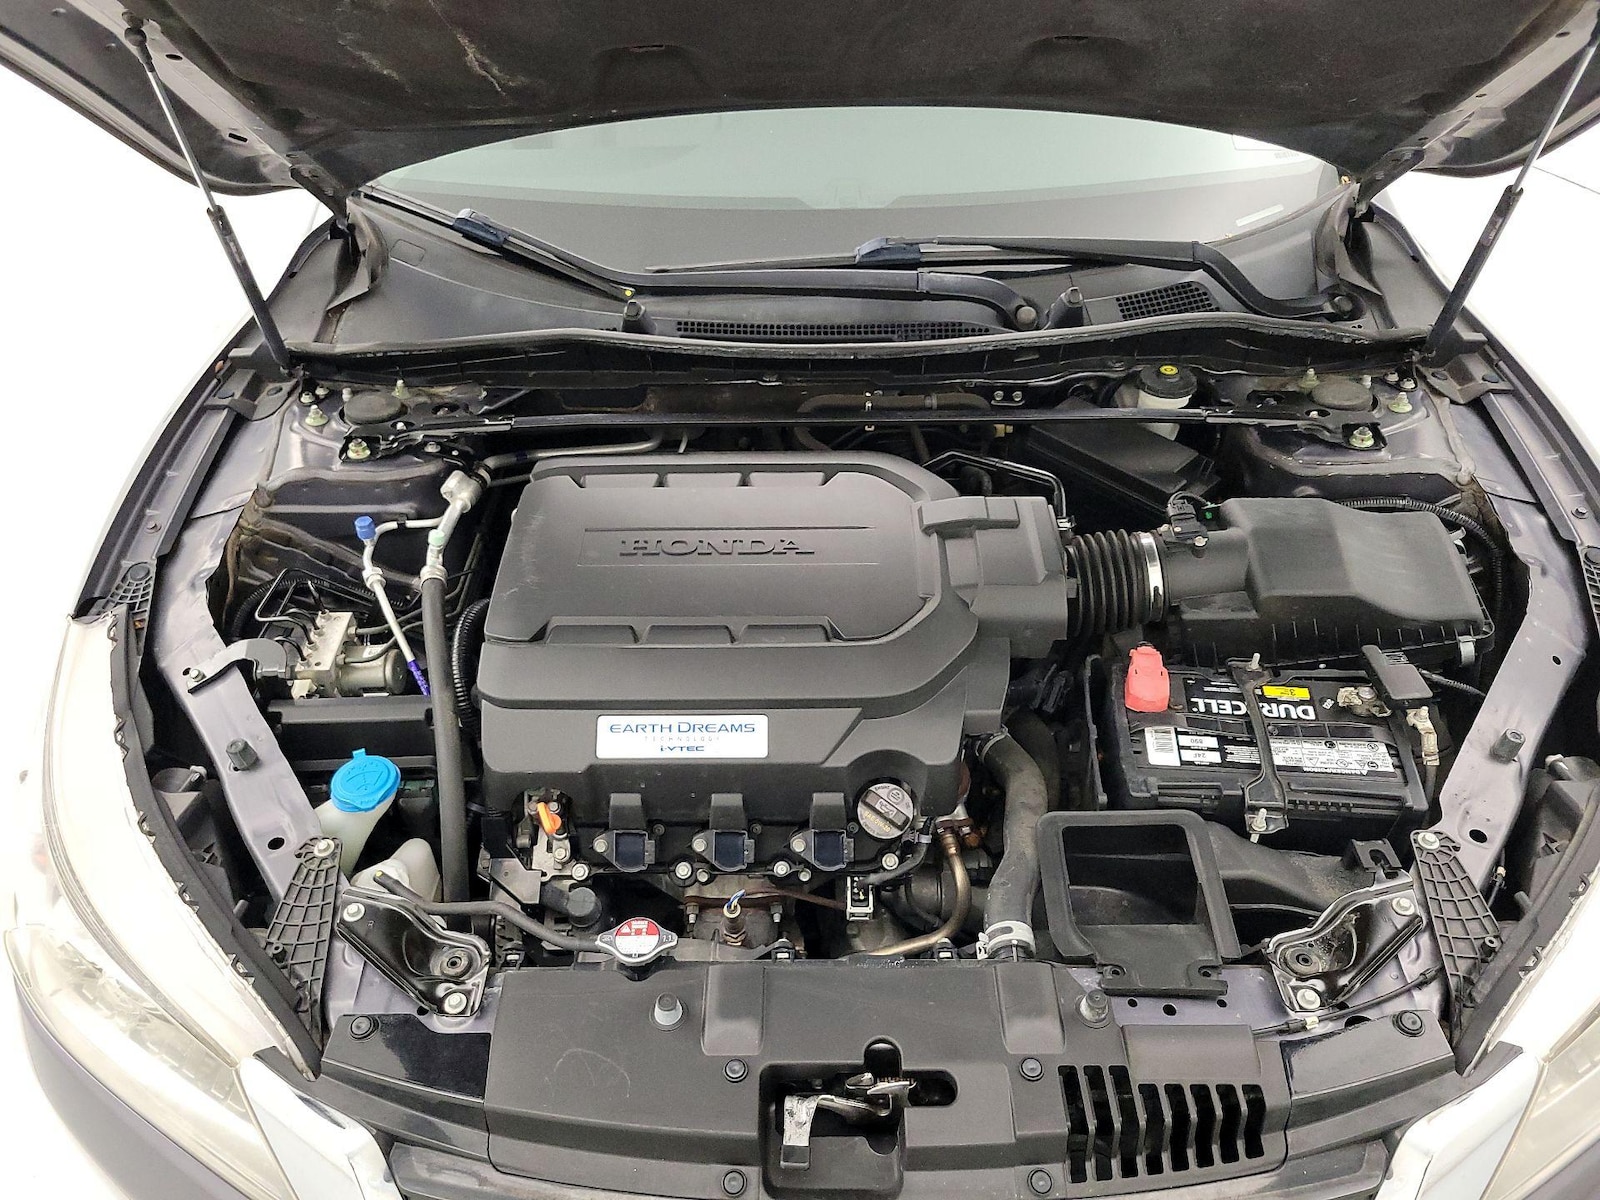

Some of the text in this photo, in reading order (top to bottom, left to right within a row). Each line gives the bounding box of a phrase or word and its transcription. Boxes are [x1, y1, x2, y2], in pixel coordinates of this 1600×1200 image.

[620, 539, 815, 557] HONDA
[1191, 697, 1316, 720] DURCELL
[609, 721, 756, 733] EARTH DREAMS
